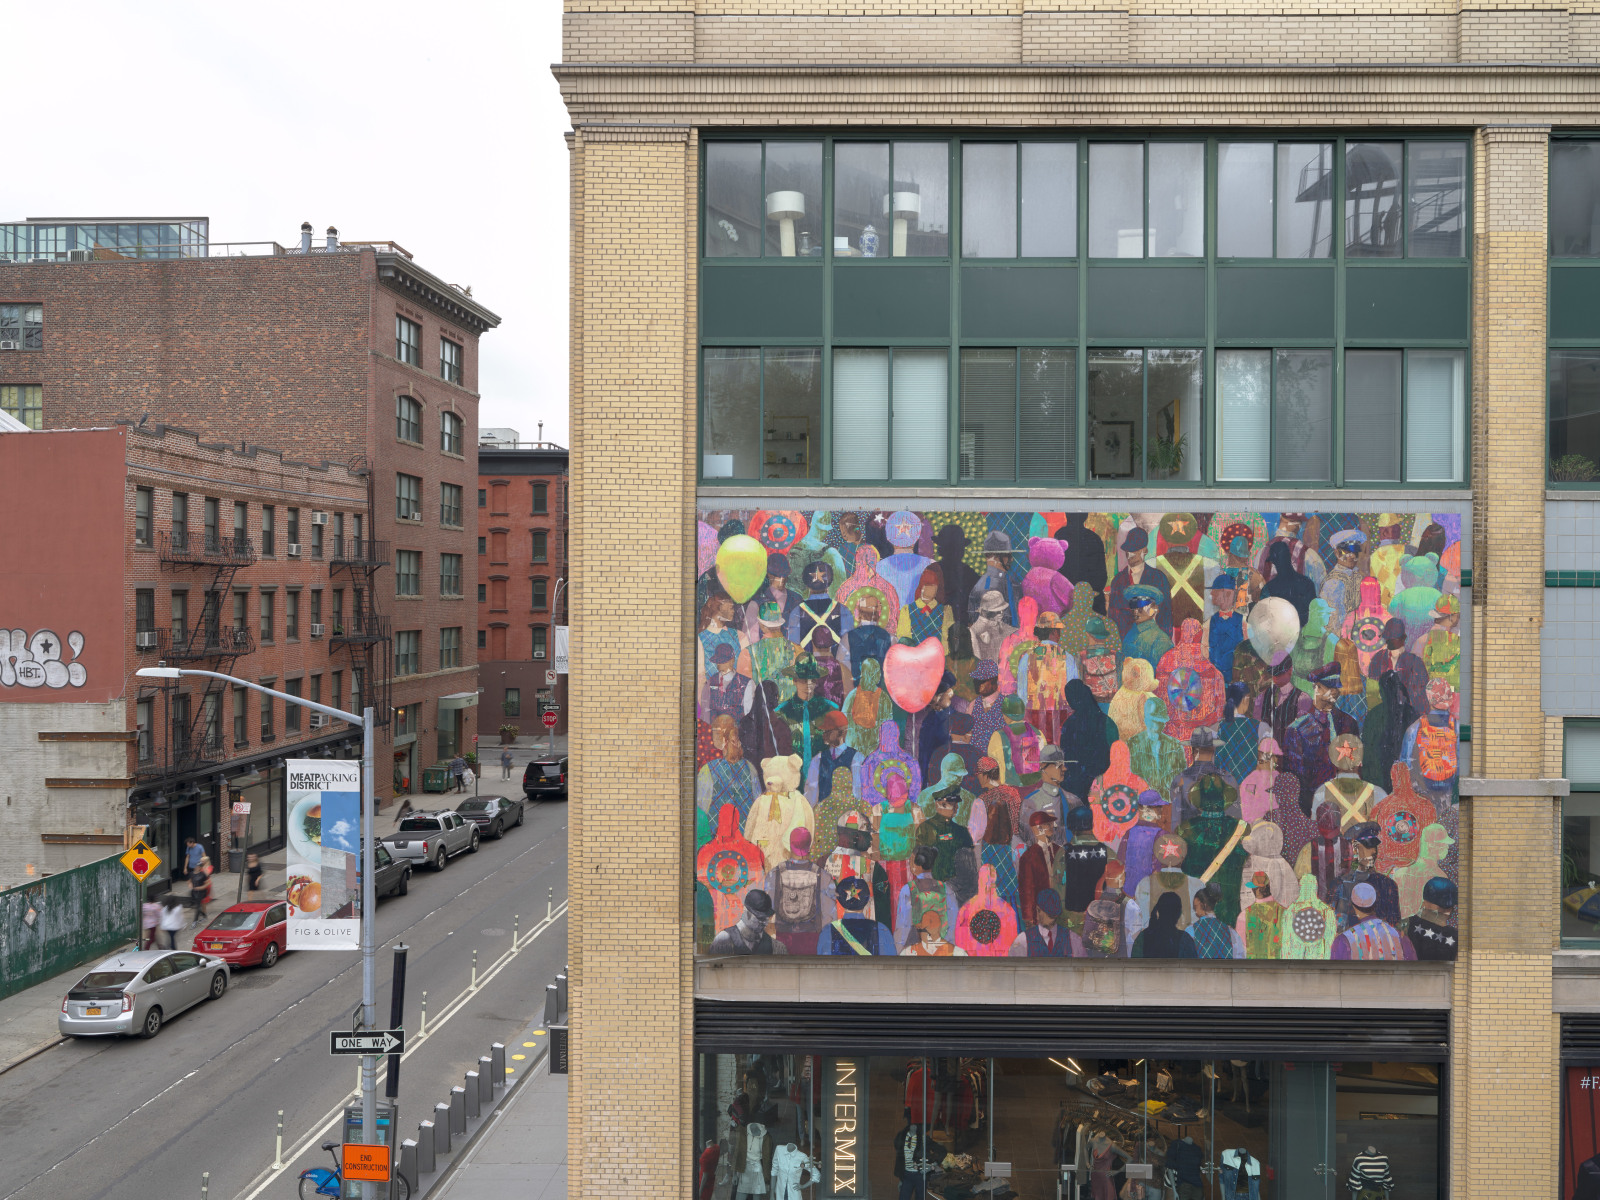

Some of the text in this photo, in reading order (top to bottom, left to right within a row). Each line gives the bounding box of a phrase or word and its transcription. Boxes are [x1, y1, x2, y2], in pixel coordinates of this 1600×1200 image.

[290, 773, 357, 782] MEATPACKING
[290, 781, 332, 790] DISTRICT
[295, 928, 352, 936] FIG & OLIVE
[341, 1037, 393, 1048] ONE WAY
[1580, 1076, 1600, 1089] #F
[834, 1062, 857, 1194] INTERMIX
[360, 1154, 372, 1162] END
[345, 1162, 388, 1172] CONSTRUCTION
